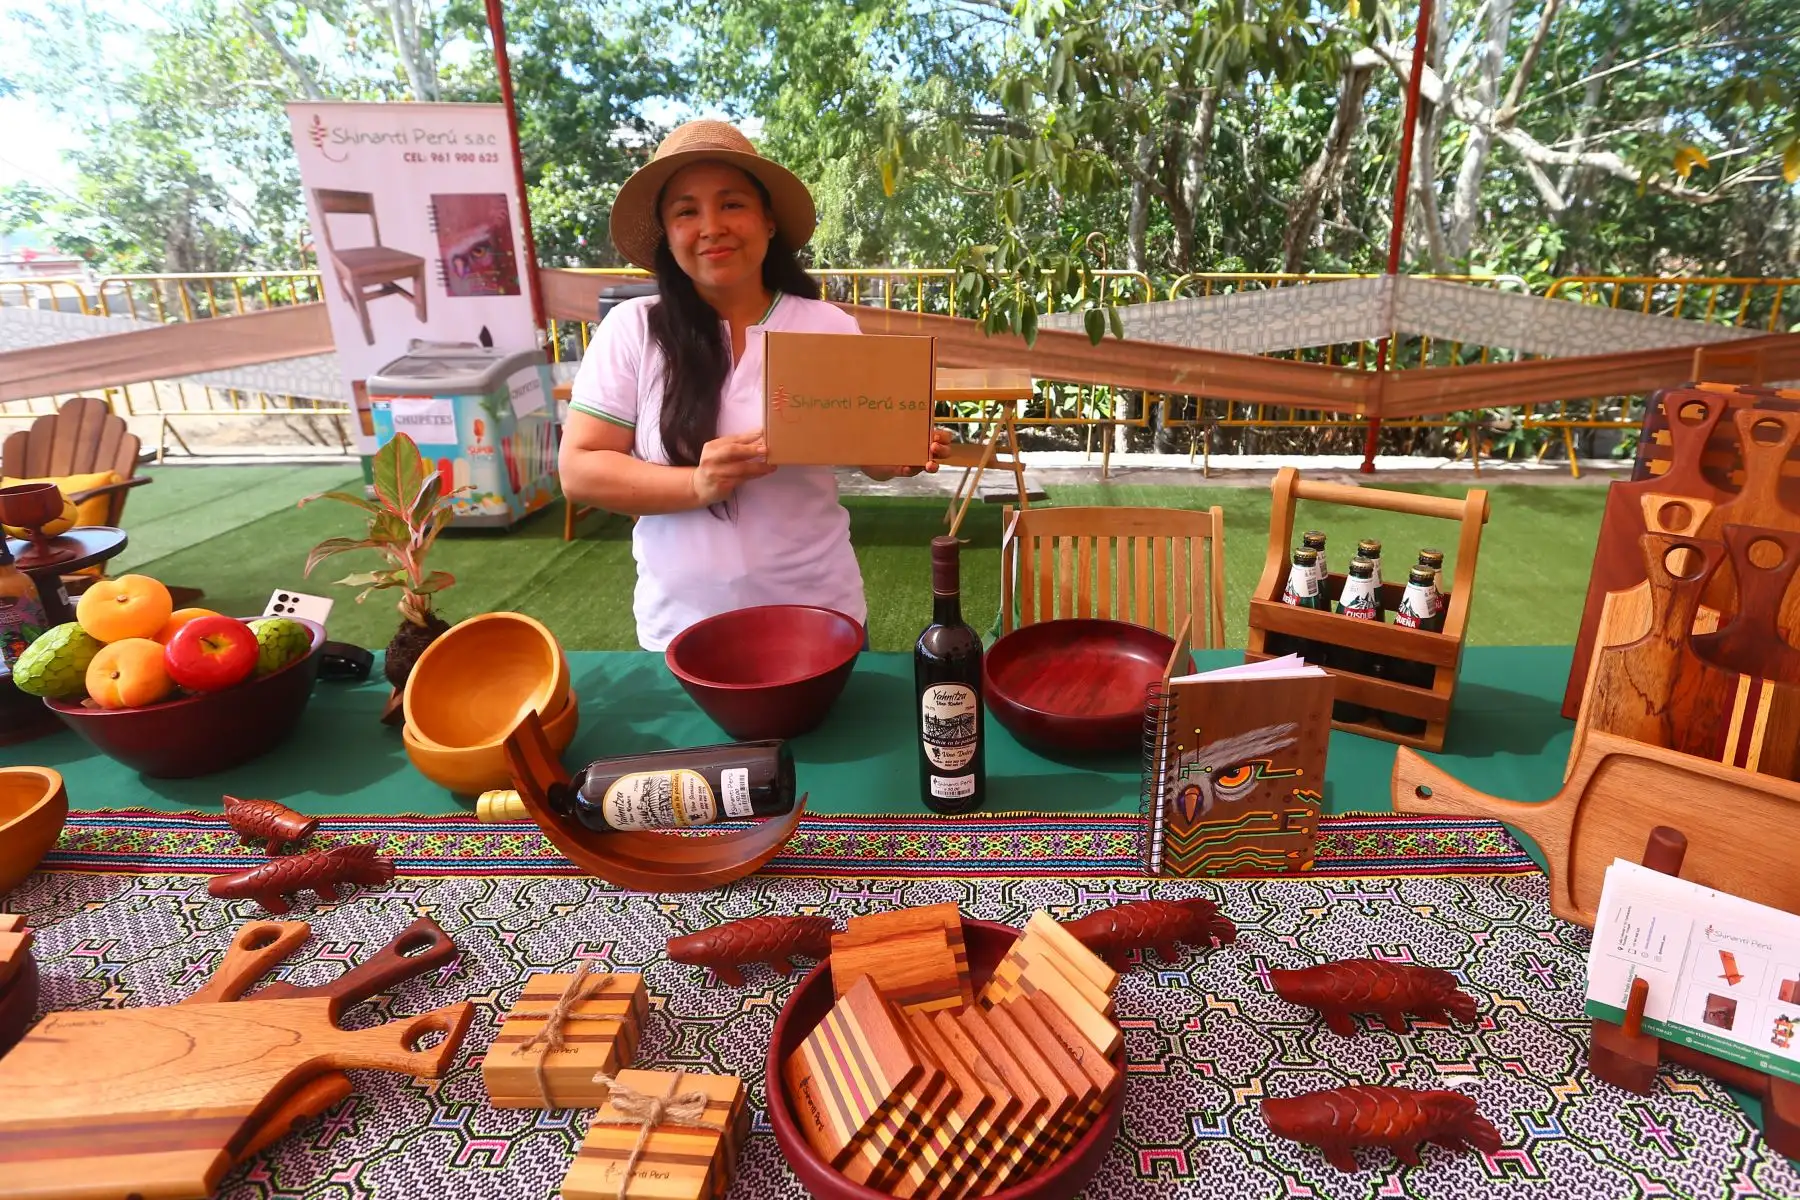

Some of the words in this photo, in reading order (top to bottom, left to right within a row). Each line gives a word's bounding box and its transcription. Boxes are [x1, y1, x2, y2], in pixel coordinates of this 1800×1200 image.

[331, 127, 408, 145] Shinanti
[412, 128, 457, 145] Perú
[430, 152, 450, 163] 961
[455, 152, 476, 163] 900
[789, 395, 852, 409] Shinanti
[857, 395, 893, 410] Perú
[395, 414, 453, 426] CHUPETES
